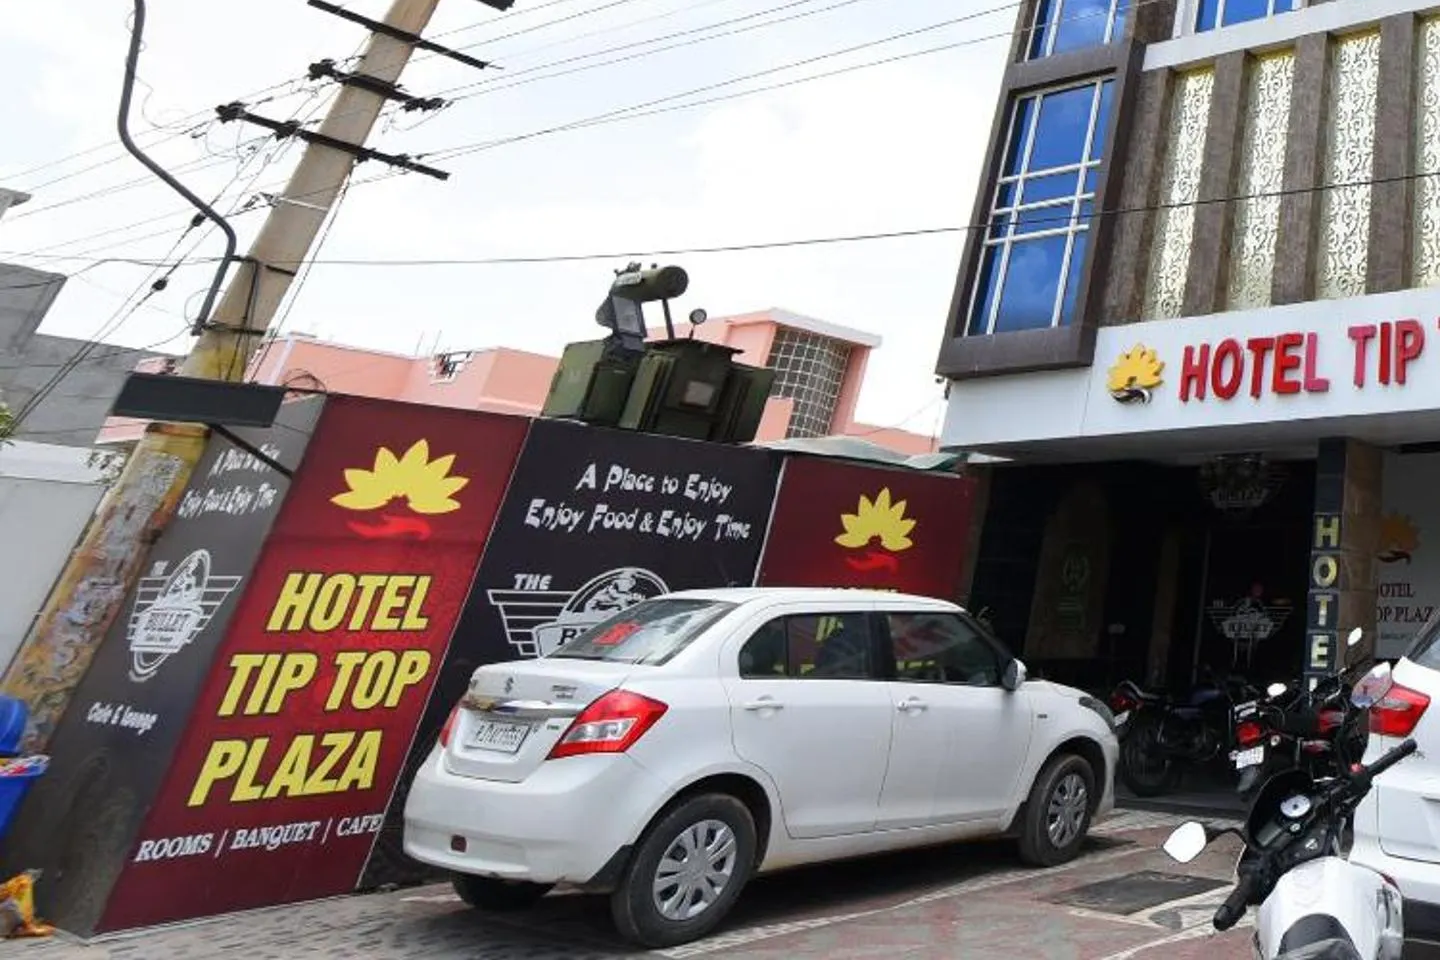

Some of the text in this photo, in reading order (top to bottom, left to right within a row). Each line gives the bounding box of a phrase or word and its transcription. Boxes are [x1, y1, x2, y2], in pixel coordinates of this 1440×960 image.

[1179, 332, 1330, 403] HOTEL
[1348, 319, 1425, 388] TIP
[575, 463, 732, 503] A Place to Enjoy
[524, 498, 751, 541] Enjoy Food & Enjoy Time
[266, 573, 431, 631] HOTEL
[514, 574, 553, 590] THE
[1377, 583, 1415, 598] OTEL
[1308, 516, 1341, 708] HOTE
[1395, 606, 1435, 623] PLAZ
[217, 650, 431, 717] TIP TOP
[187, 730, 383, 807] PLAZA
[134, 833, 214, 862] ROOMS
[230, 821, 321, 851] BANQUET
[336, 813, 384, 836] CAFE
